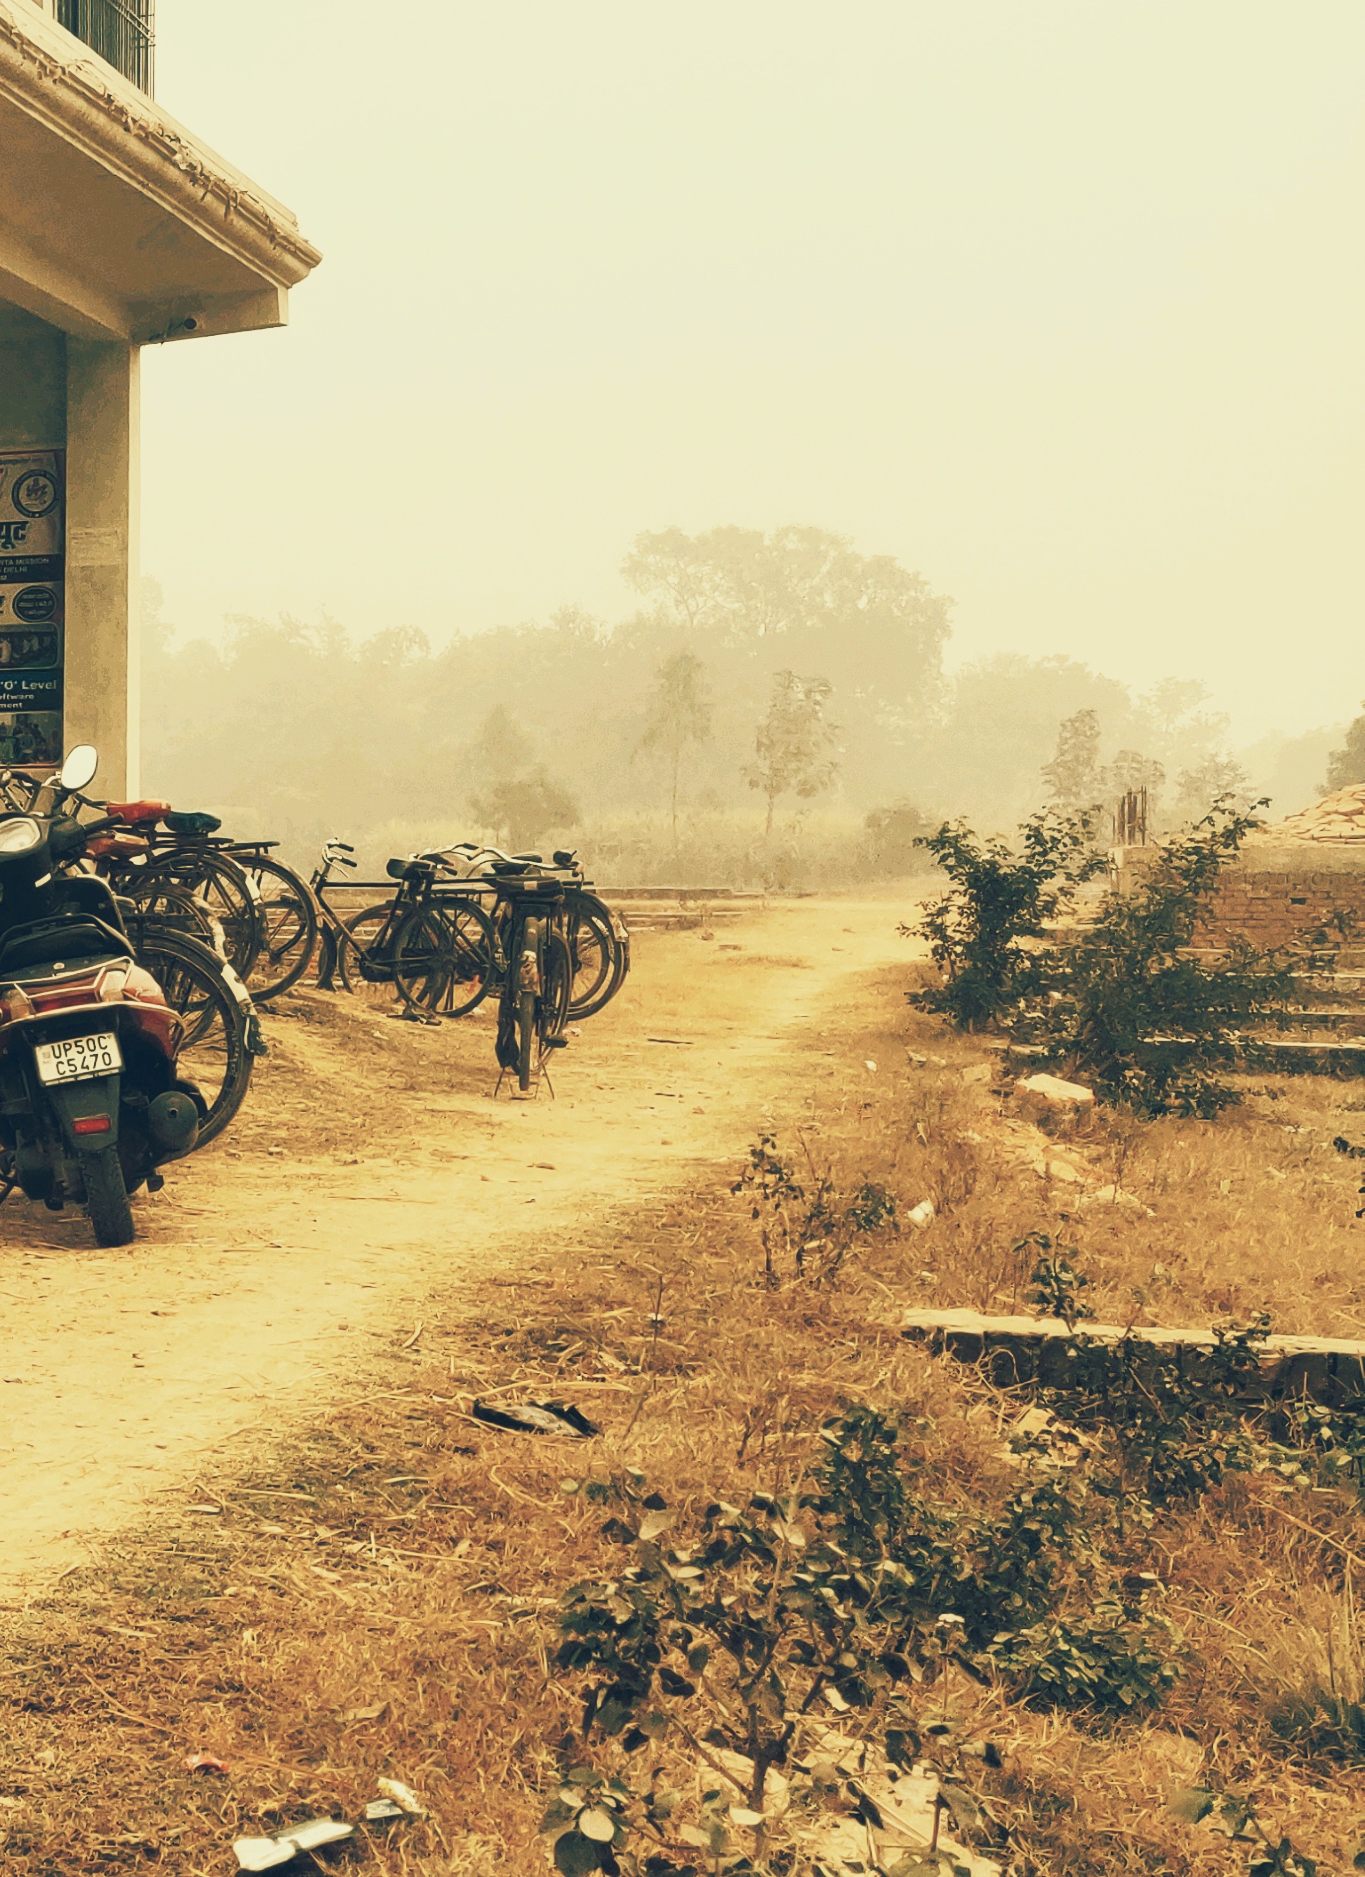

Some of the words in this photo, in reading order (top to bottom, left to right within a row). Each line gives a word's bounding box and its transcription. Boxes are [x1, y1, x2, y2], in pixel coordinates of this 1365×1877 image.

[3, 565, 28, 574] DELHI
[21, 680, 57, 691] Level
[50, 1035, 108, 1060] UP50C
[55, 1051, 112, 1076] C5470
